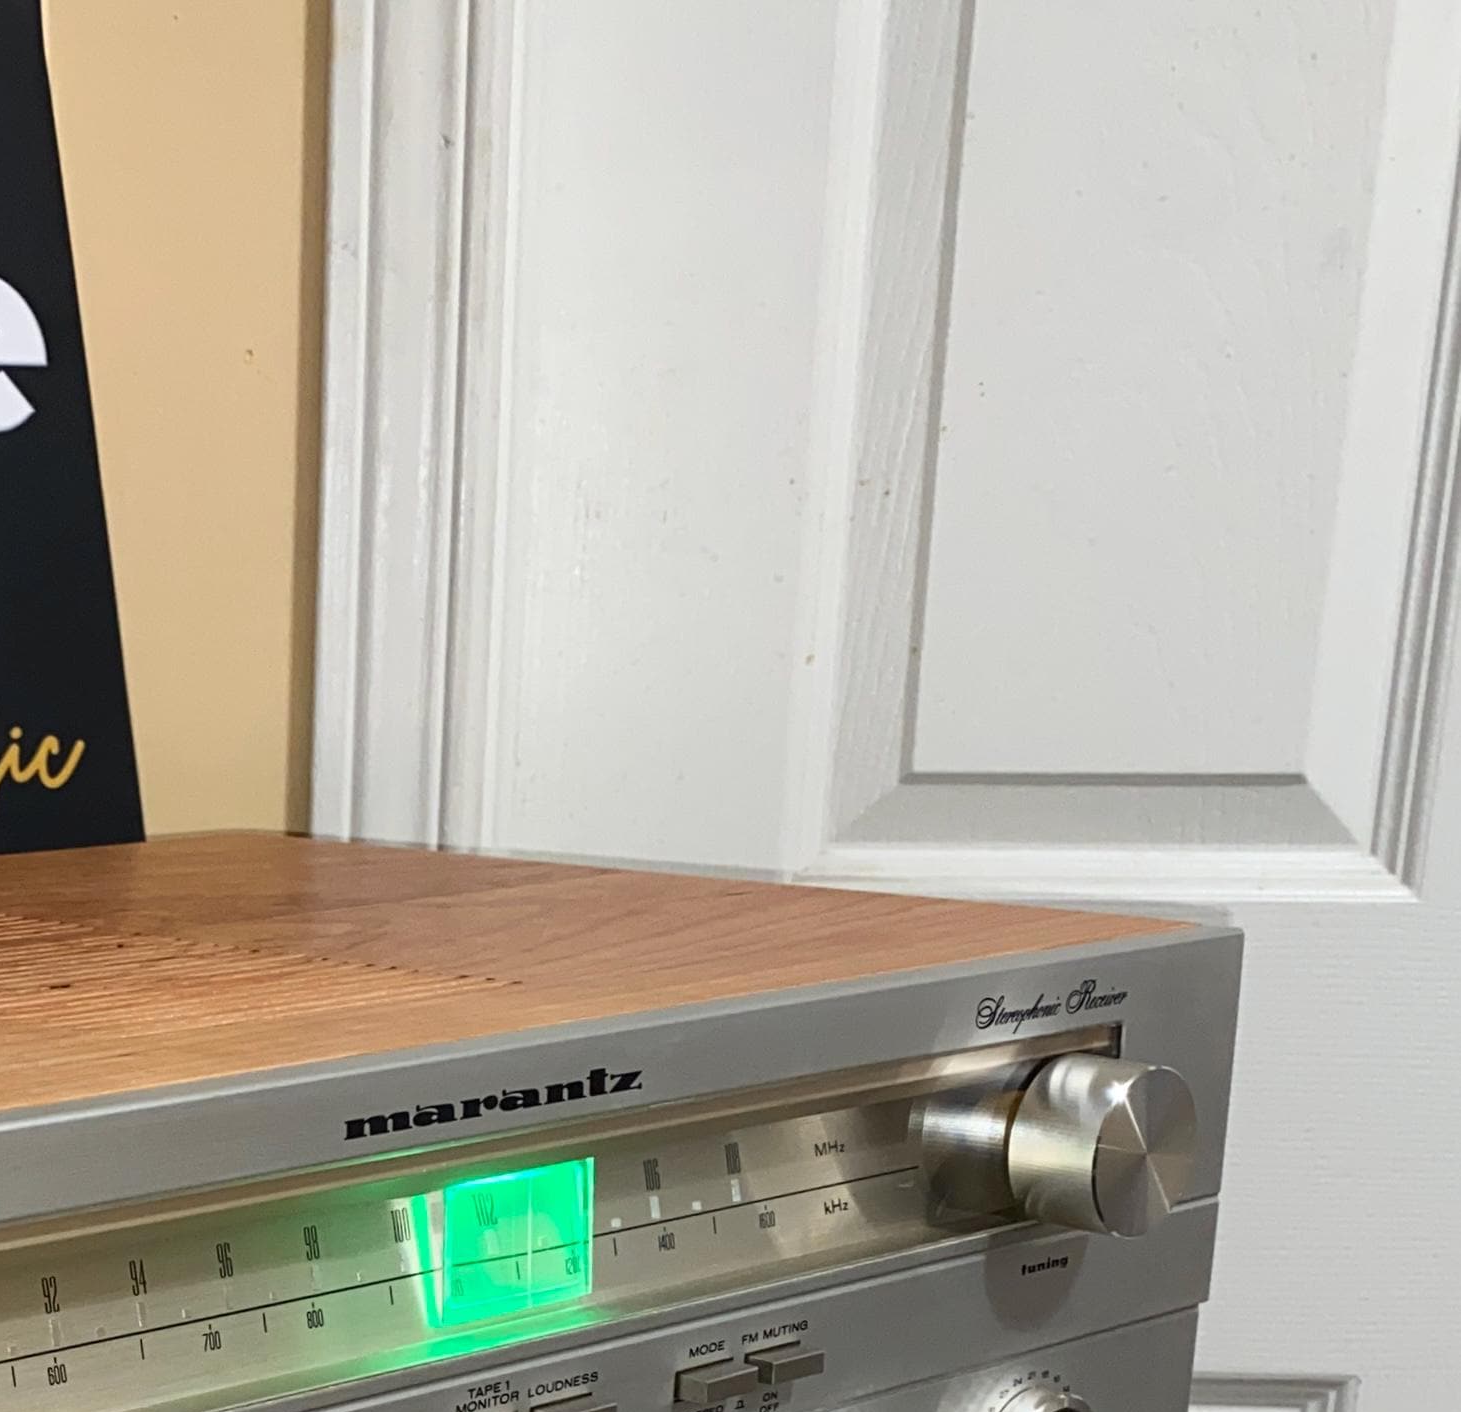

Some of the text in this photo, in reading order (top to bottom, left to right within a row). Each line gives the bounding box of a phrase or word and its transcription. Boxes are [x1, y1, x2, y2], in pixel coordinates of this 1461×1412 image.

[1065, 979, 1129, 1015] Receiver
[343, 1067, 644, 1141] marantz
[41, 1275, 61, 1315] 92
[128, 1259, 148, 1297] 94
[215, 1242, 234, 1279] 96
[303, 1225, 321, 1261] 98
[390, 1208, 412, 1244] 100
[814, 1140, 846, 1158] MHz
[1021, 1255, 1069, 1276] tuning
[46, 1363, 68, 1386] 600
[202, 1330, 222, 1353] 700
[824, 1198, 849, 1216] kHz
[741, 1320, 809, 1346] FM MUTING
[689, 1340, 726, 1358] MODE
[467, 1380, 511, 1400] TAPE 1
[527, 1371, 600, 1399] LOUDNESS
[762, 1391, 779, 1403] ON
